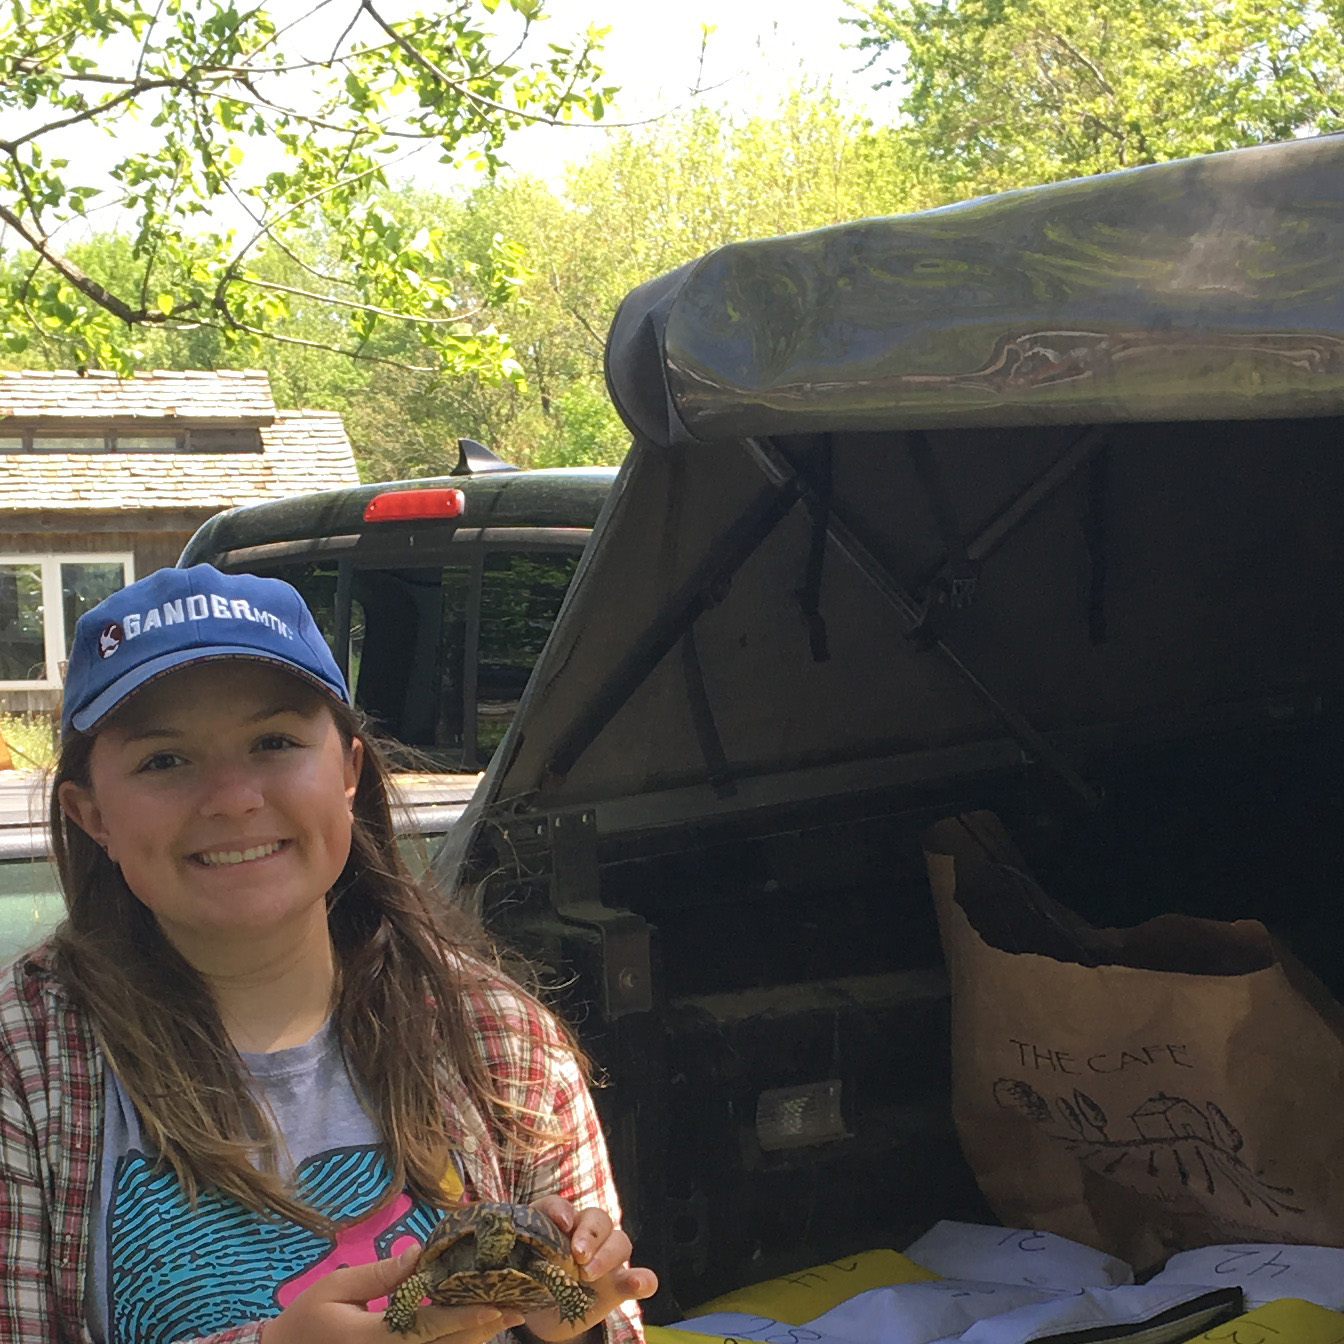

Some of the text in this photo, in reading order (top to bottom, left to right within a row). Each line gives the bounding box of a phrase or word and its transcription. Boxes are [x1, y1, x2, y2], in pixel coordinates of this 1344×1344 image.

[122, 593, 257, 641] GANDER
[1008, 1038, 1195, 1076] THE CAFE
[1214, 1247, 1291, 1278] 42
